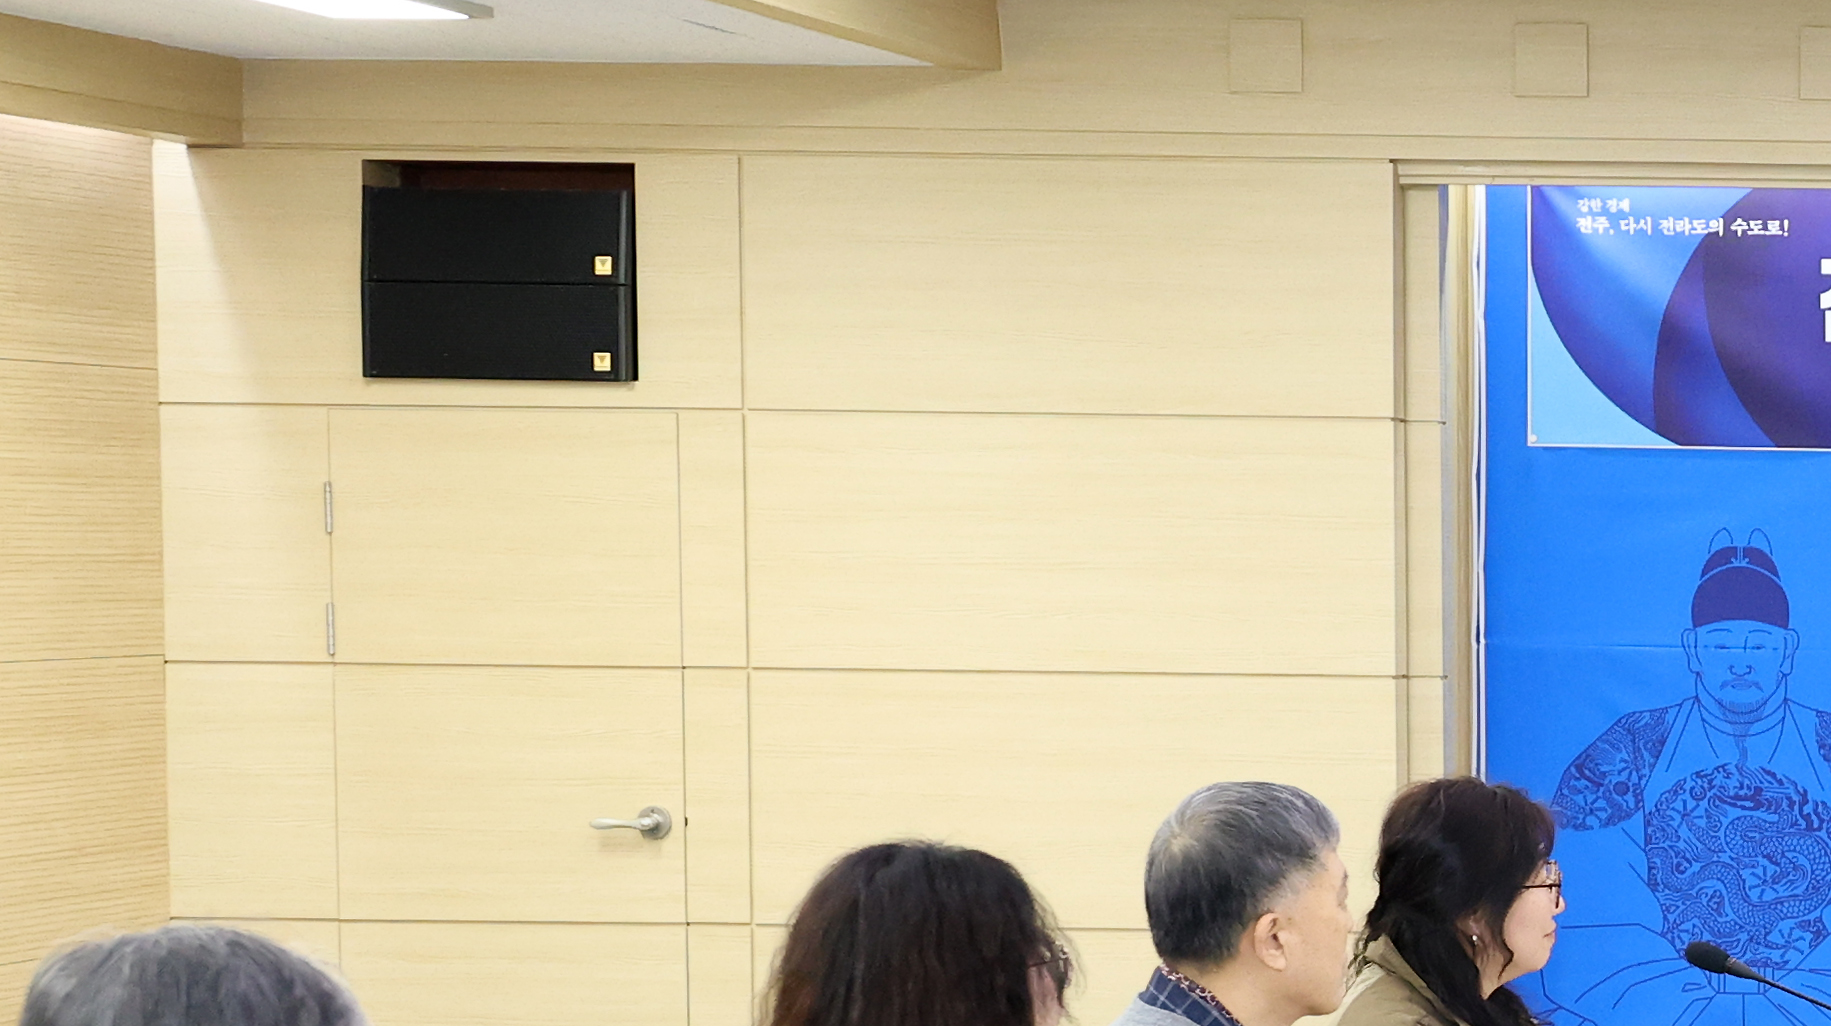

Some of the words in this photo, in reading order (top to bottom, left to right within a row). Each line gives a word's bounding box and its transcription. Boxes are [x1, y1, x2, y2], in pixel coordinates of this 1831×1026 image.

[1577, 198, 1602, 213] 강한
[1606, 198, 1630, 213] 경제
[1576, 216, 1614, 235] 전주,
[1619, 216, 1652, 236] 다시
[1658, 217, 1724, 237] 전라도의
[1730, 218, 1789, 237] 수도로!
